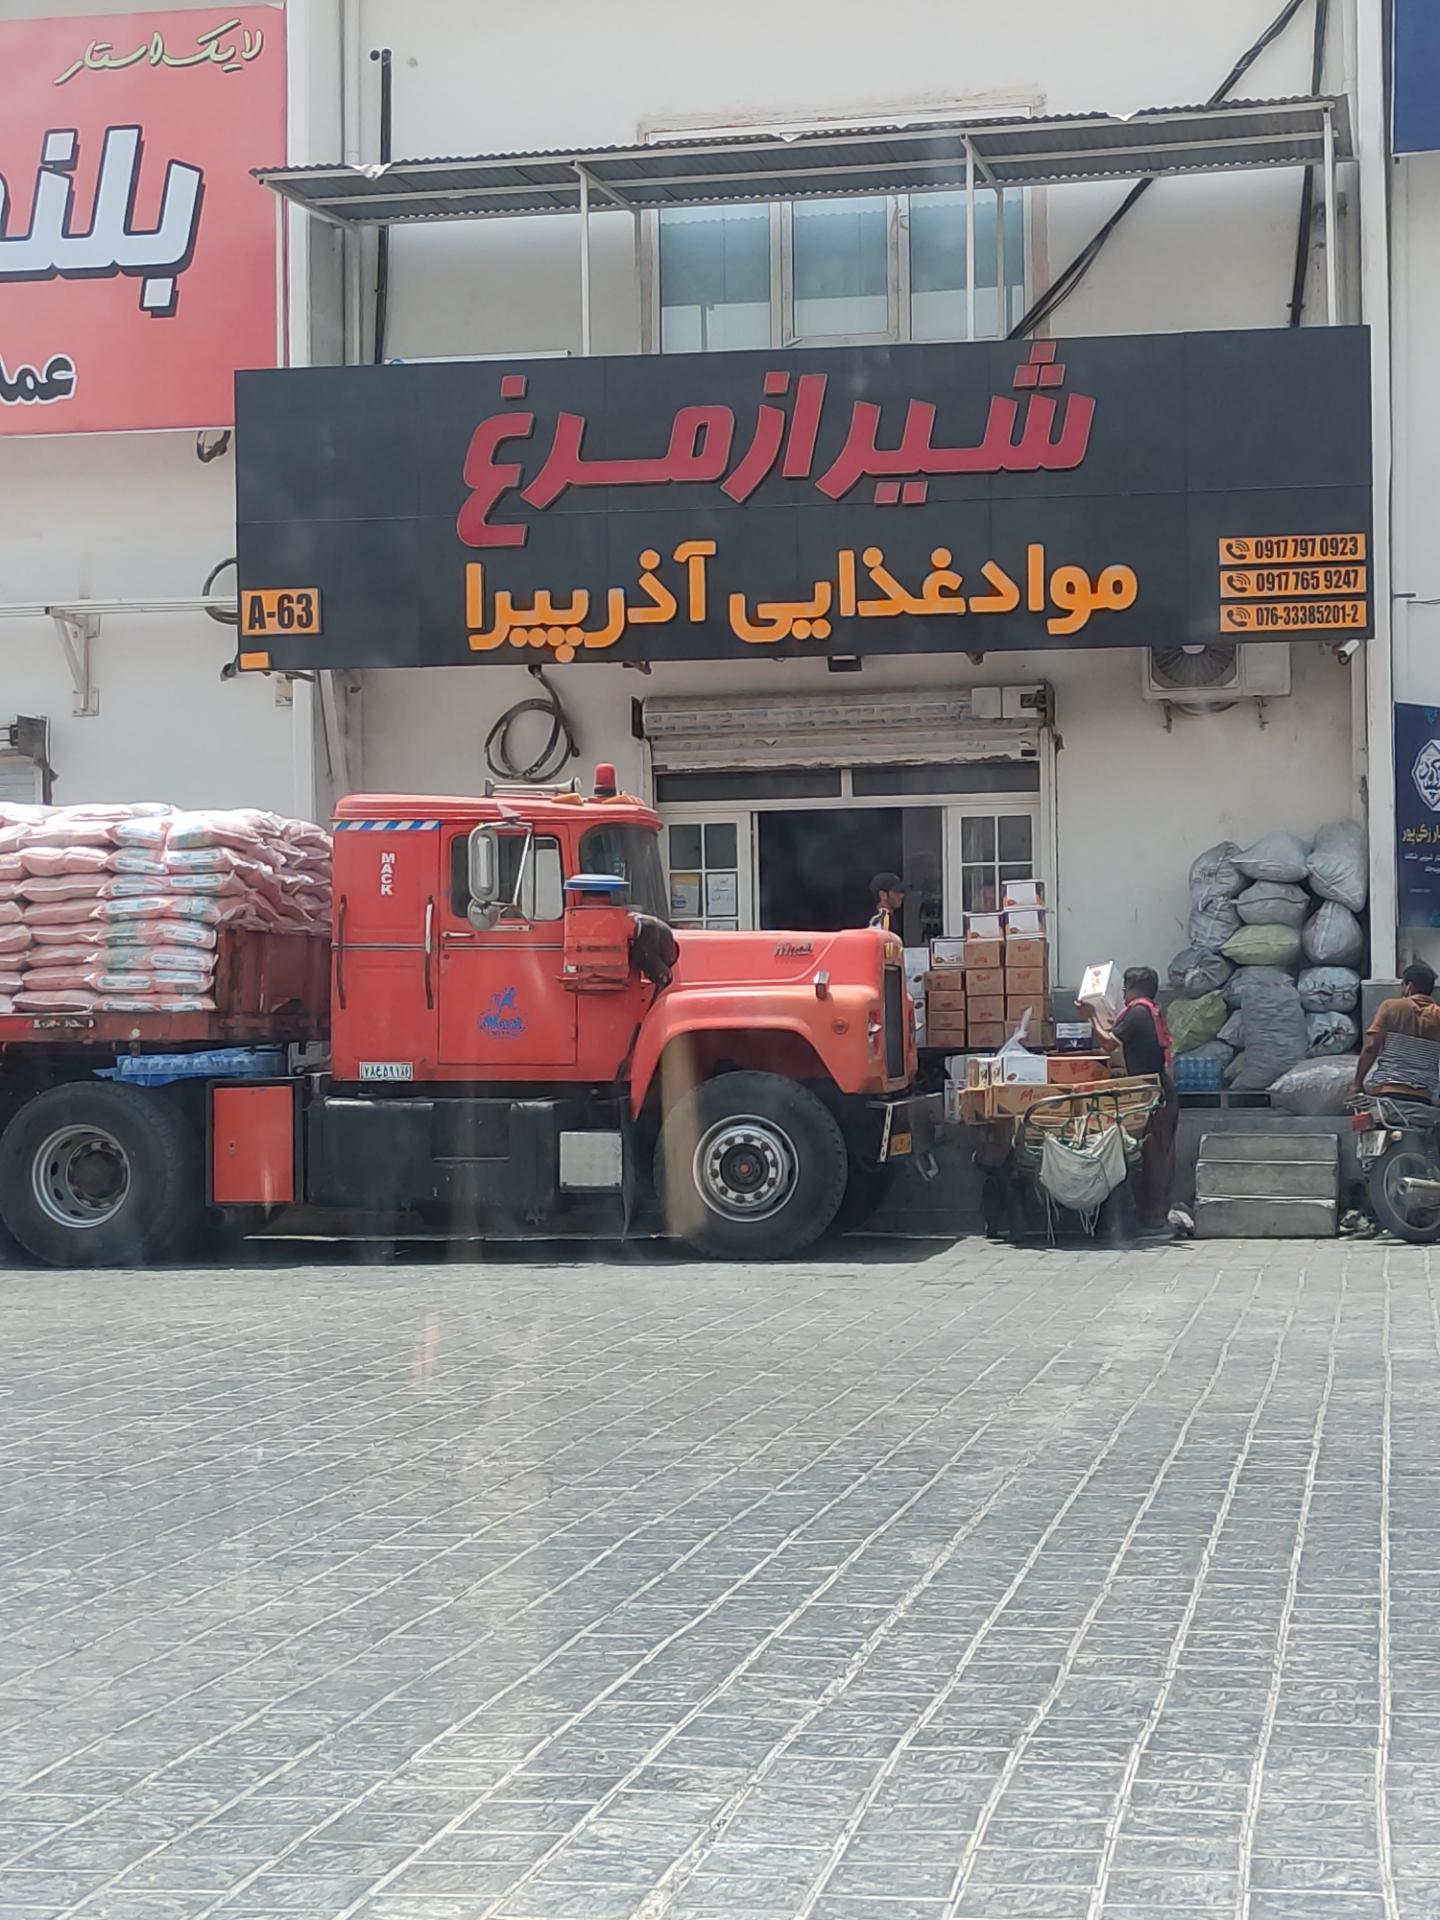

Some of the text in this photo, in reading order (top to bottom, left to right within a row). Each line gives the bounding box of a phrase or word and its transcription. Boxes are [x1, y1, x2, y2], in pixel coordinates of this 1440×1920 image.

[456, 374, 735, 548] مرغ
[1255, 536, 1358, 559] 0917 797 0923
[1256, 569, 1359, 592] 0917 765 9247
[248, 593, 313, 630] A-63
[1256, 604, 1359, 626] 076-33385201-2
[381, 852, 395, 896] MACK
